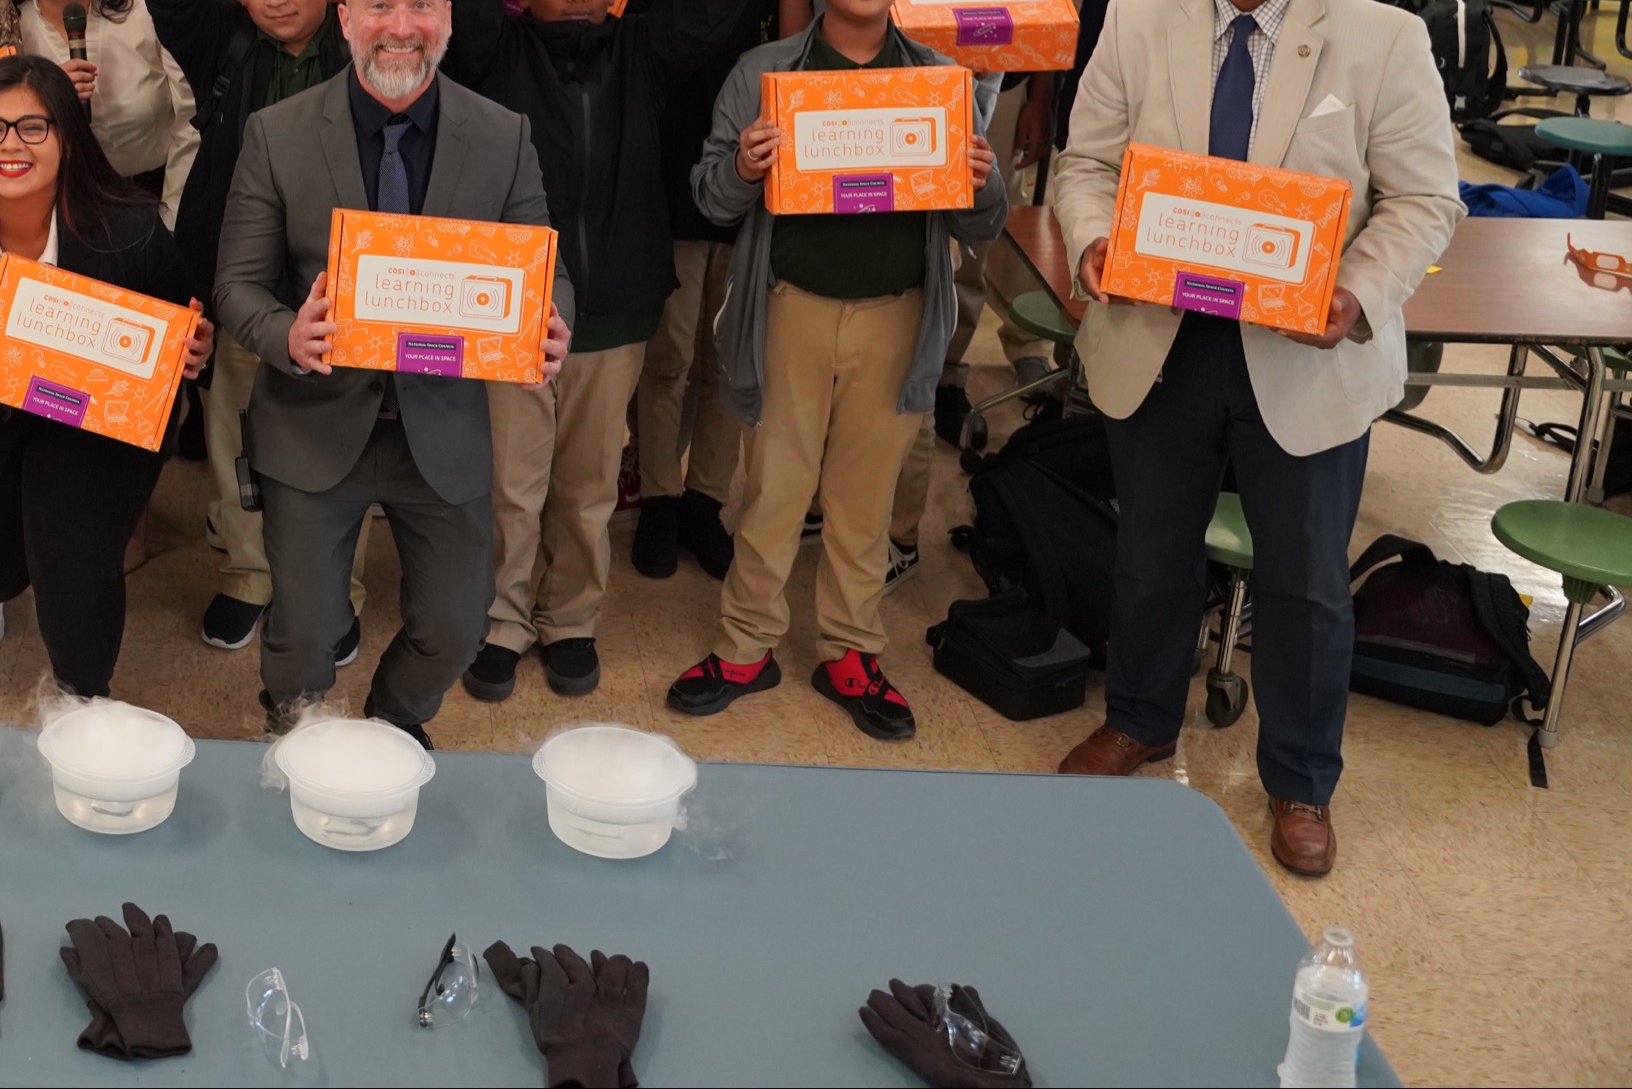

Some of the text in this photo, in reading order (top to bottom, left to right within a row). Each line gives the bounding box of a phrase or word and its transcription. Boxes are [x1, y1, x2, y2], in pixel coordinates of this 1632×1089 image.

[812, 128, 884, 142] learning
[804, 144, 884, 158] lunchbox
[1158, 212, 1240, 244] learning
[1206, 214, 1242, 225] connects
[1147, 227, 1236, 257] lunchbox
[420, 271, 455, 279] connects
[375, 274, 455, 298] learning
[365, 293, 452, 313] lunchbox
[1219, 297, 1235, 305] SPACE
[30, 298, 101, 335] learning
[17, 312, 96, 348] lunchbox
[44, 400, 58, 409] PLACE
[64, 406, 78, 416] SPACE
